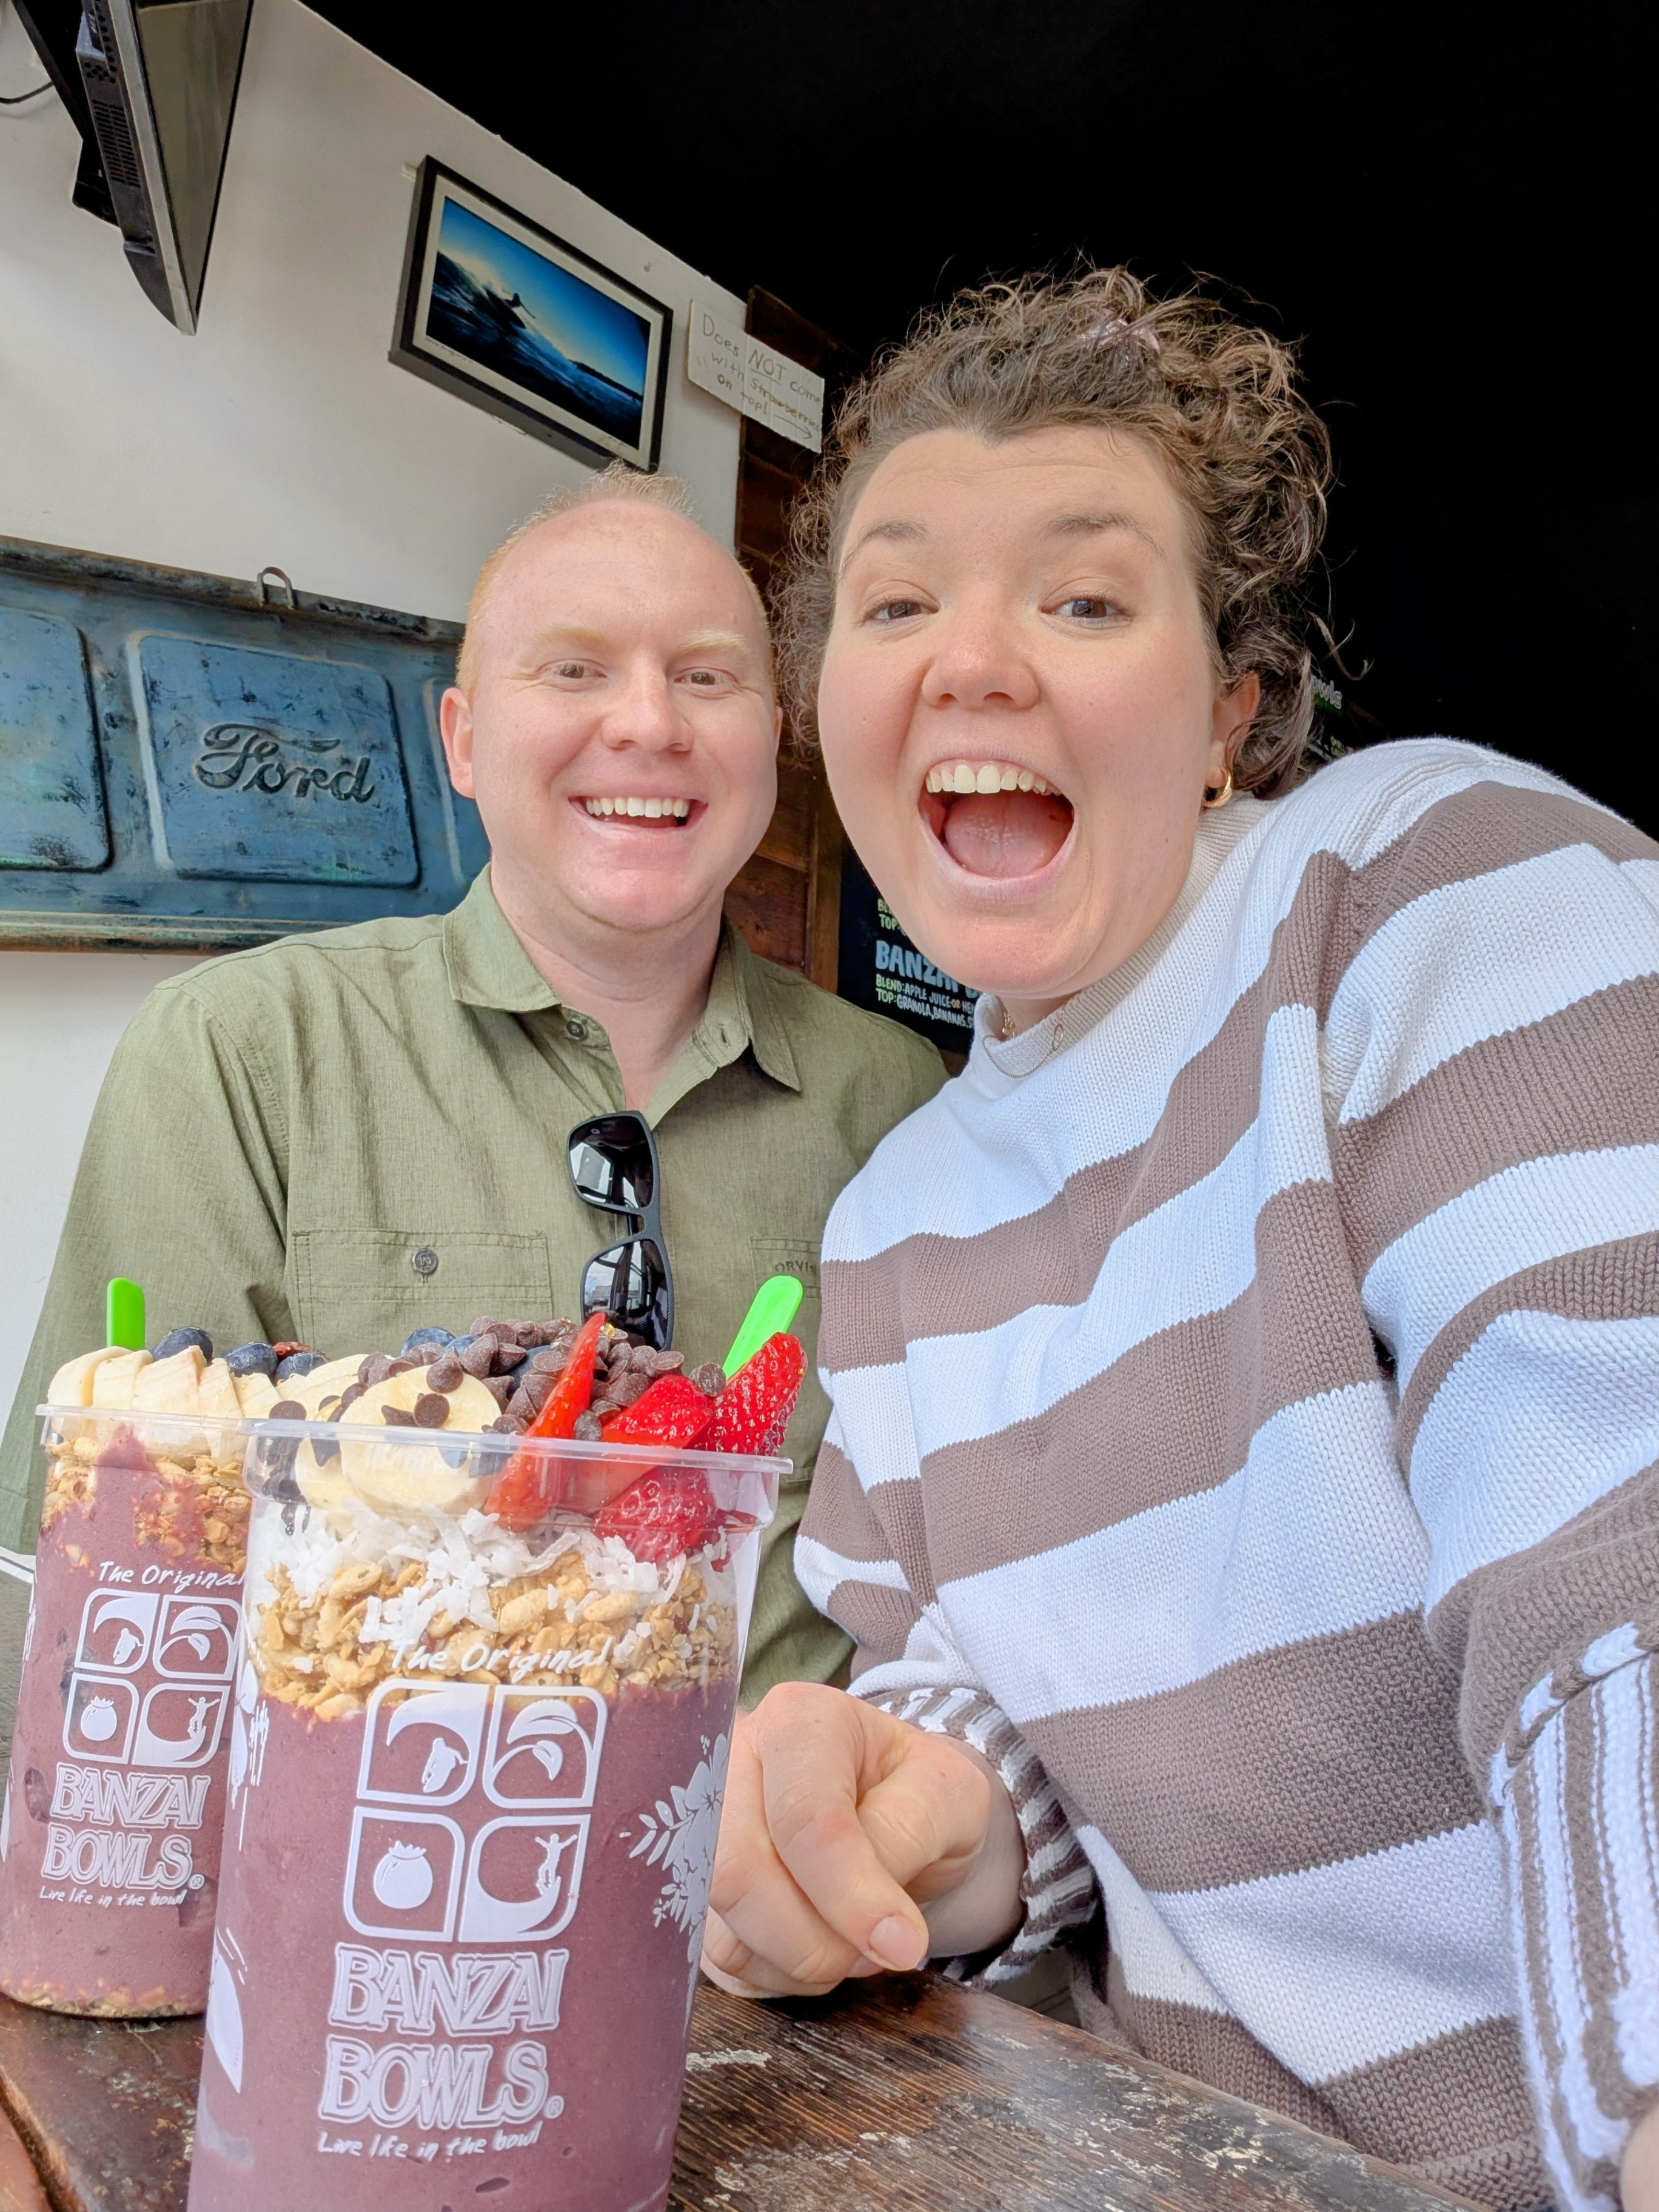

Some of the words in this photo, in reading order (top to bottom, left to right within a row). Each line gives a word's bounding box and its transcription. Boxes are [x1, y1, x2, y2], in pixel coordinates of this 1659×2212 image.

[703, 313, 740, 357] Does
[748, 349, 788, 381] NOT
[790, 381, 822, 406] come
[712, 352, 745, 382] with
[717, 374, 732, 390] on
[194, 722, 376, 804] Ford
[99, 1561, 135, 1583] The
[141, 1564, 246, 1595] Original
[390, 1638, 450, 1670] The
[461, 1637, 615, 1684] Original
[50, 1761, 212, 1830] BANZAI
[39, 1885, 66, 1902] Live
[69, 1887, 93, 1905] life
[98, 1894, 113, 1909] in
[118, 1894, 146, 1906] the
[152, 1889, 188, 1906] bowl
[328, 1942, 570, 2037] BANZAI
[317, 2131, 363, 2157] Live
[369, 2133, 410, 2158] life
[415, 2141, 440, 2162] in
[444, 2136, 488, 2157] the
[491, 2120, 543, 2152] bowl
